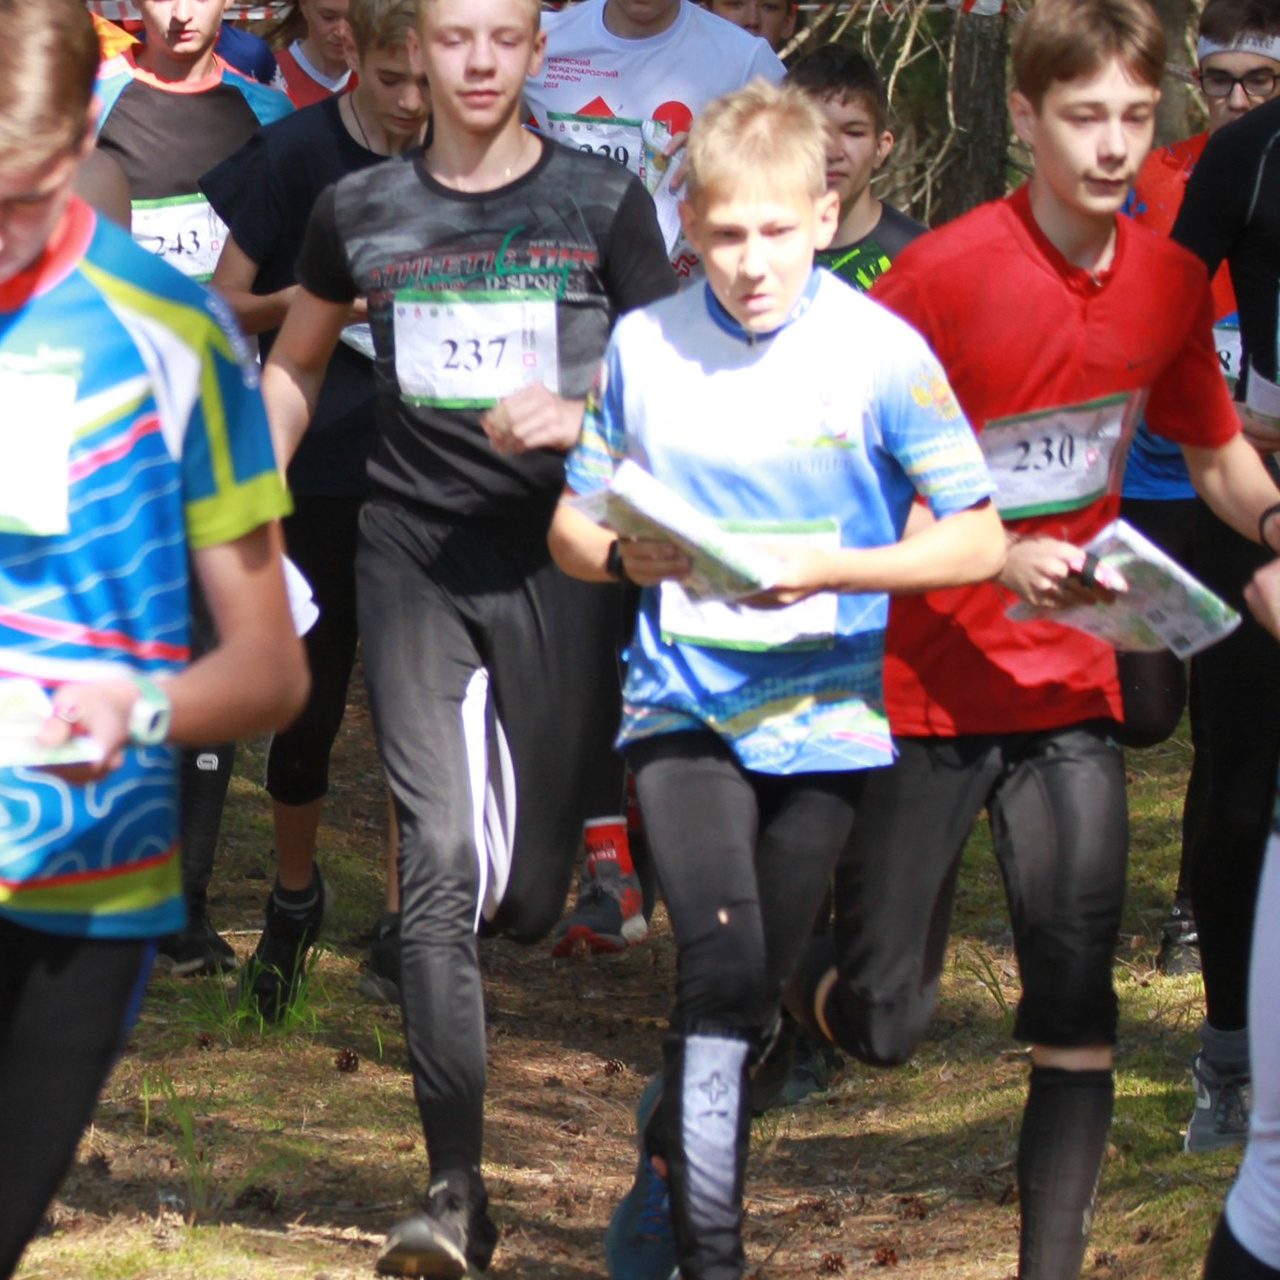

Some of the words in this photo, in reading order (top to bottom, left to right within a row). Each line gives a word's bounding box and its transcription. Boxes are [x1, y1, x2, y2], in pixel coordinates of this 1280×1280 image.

[547, 57, 591, 66] ПЕРМСКИЙ
[548, 64, 619, 78] МЕЖДУНАРОДНЫЙ
[546, 73, 582, 83] МАРАФОН
[155, 230, 200, 257] 243
[441, 337, 507, 372] 237
[1012, 434, 1075, 472] 230
